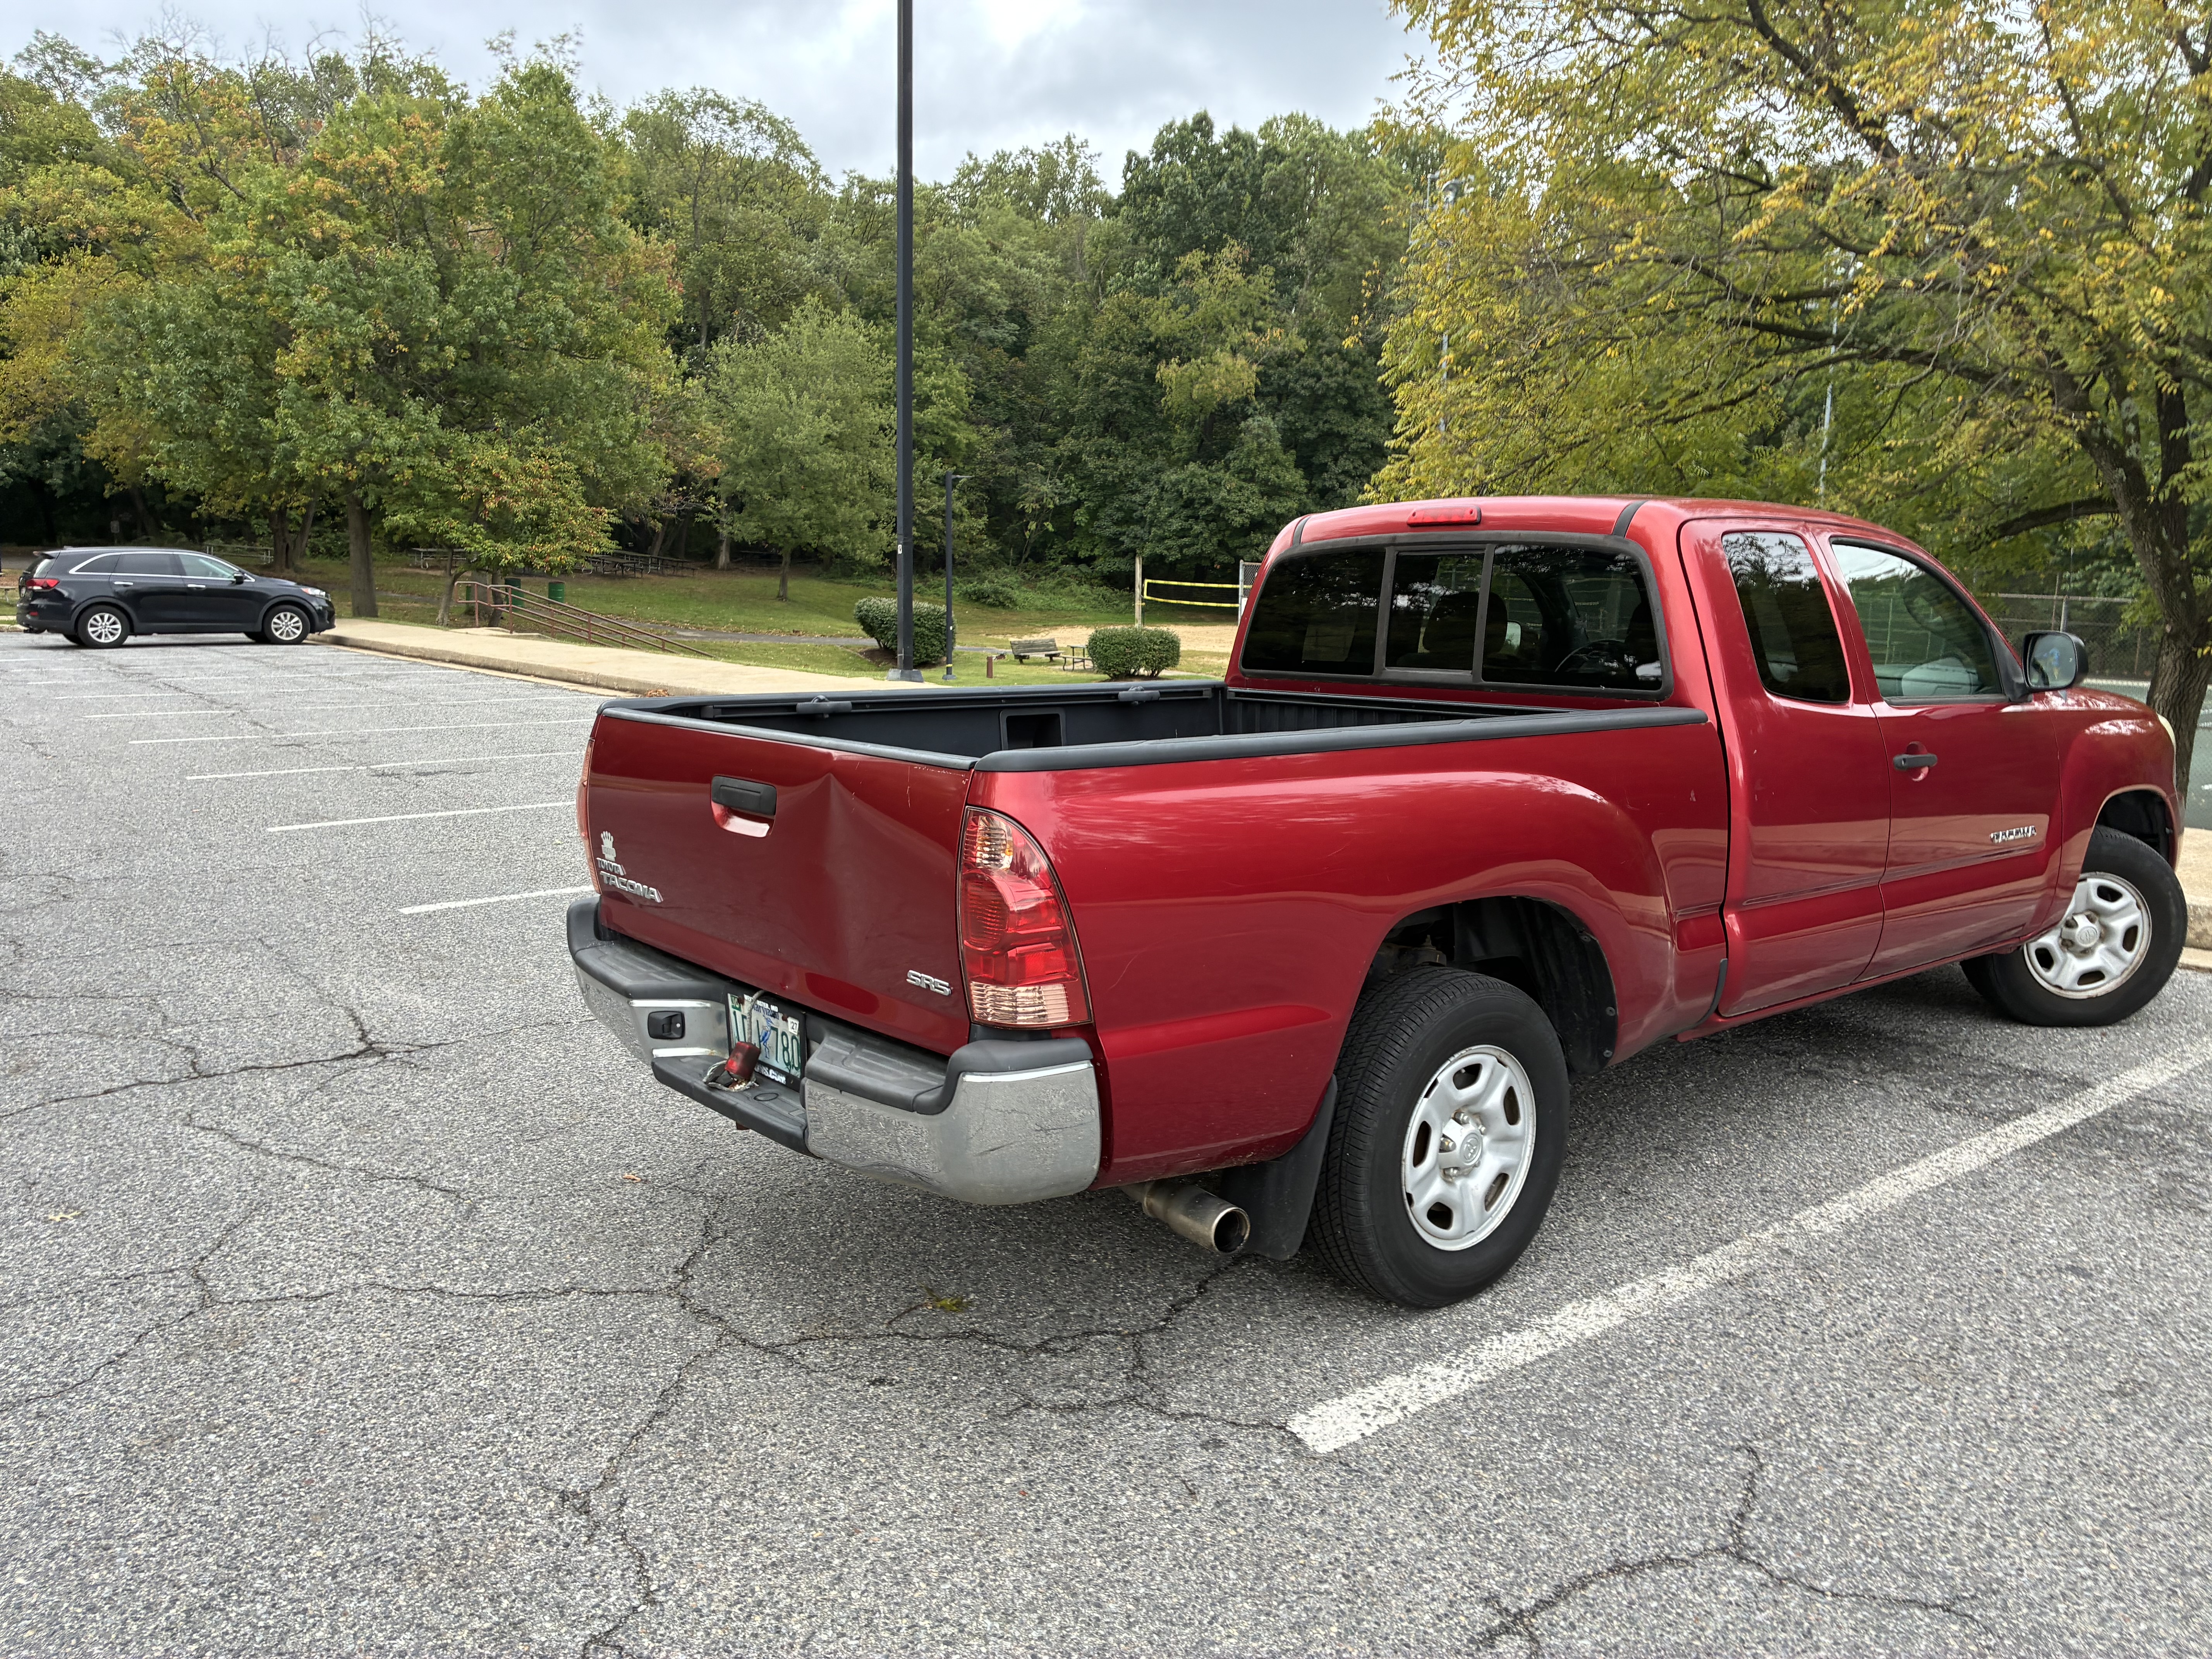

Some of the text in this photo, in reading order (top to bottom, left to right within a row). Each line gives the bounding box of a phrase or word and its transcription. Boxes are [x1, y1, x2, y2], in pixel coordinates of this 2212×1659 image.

[1990, 825, 2037, 844] TACOMA
[596, 857, 625, 876] TOYOTA
[600, 871, 661, 903] TACOMA
[906, 970, 951, 996] SR5
